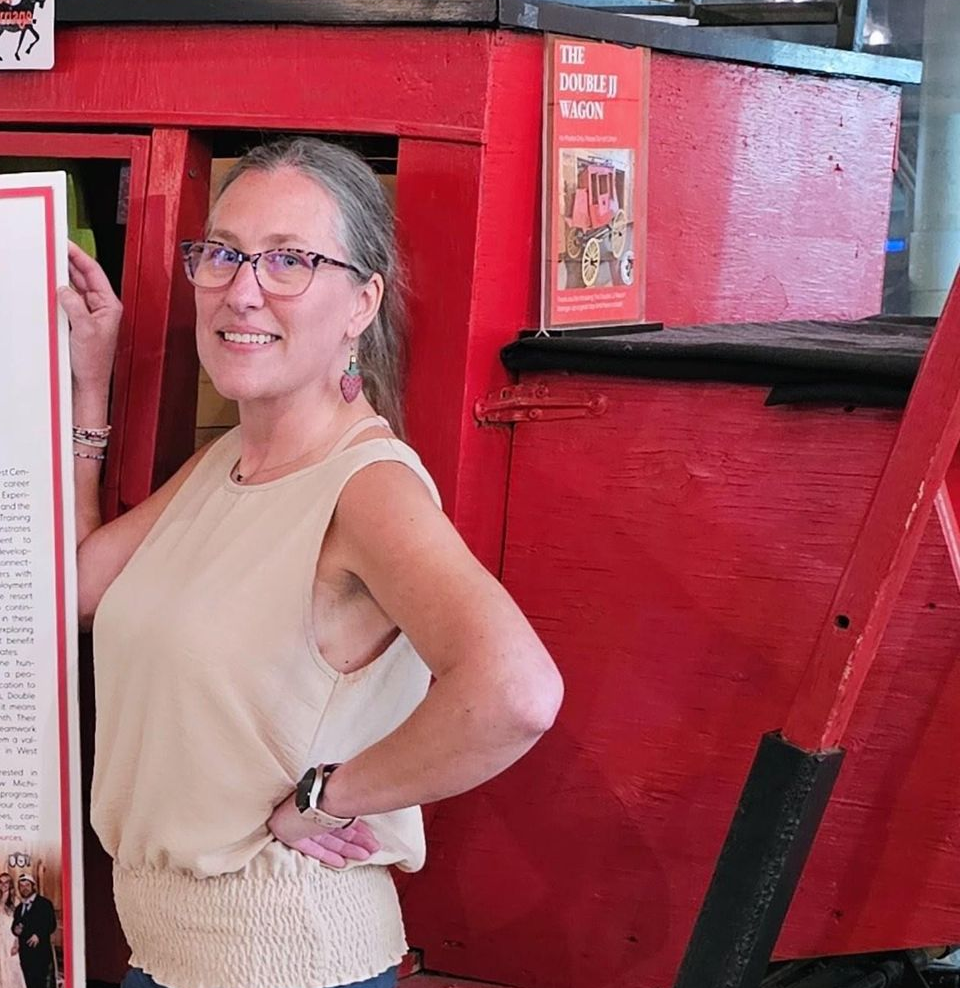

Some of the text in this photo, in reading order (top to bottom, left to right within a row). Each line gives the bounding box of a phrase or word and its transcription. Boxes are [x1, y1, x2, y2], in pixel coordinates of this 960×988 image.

[560, 44, 585, 65] THE
[560, 73, 618, 98] DOUBLE JJ
[560, 100, 604, 120] WAGON
[1, 502, 16, 510] and
[18, 502, 30, 510] the
[0, 514, 31, 523] Training
[6, 636, 34, 644] benefit
[5, 822, 26, 830] team
